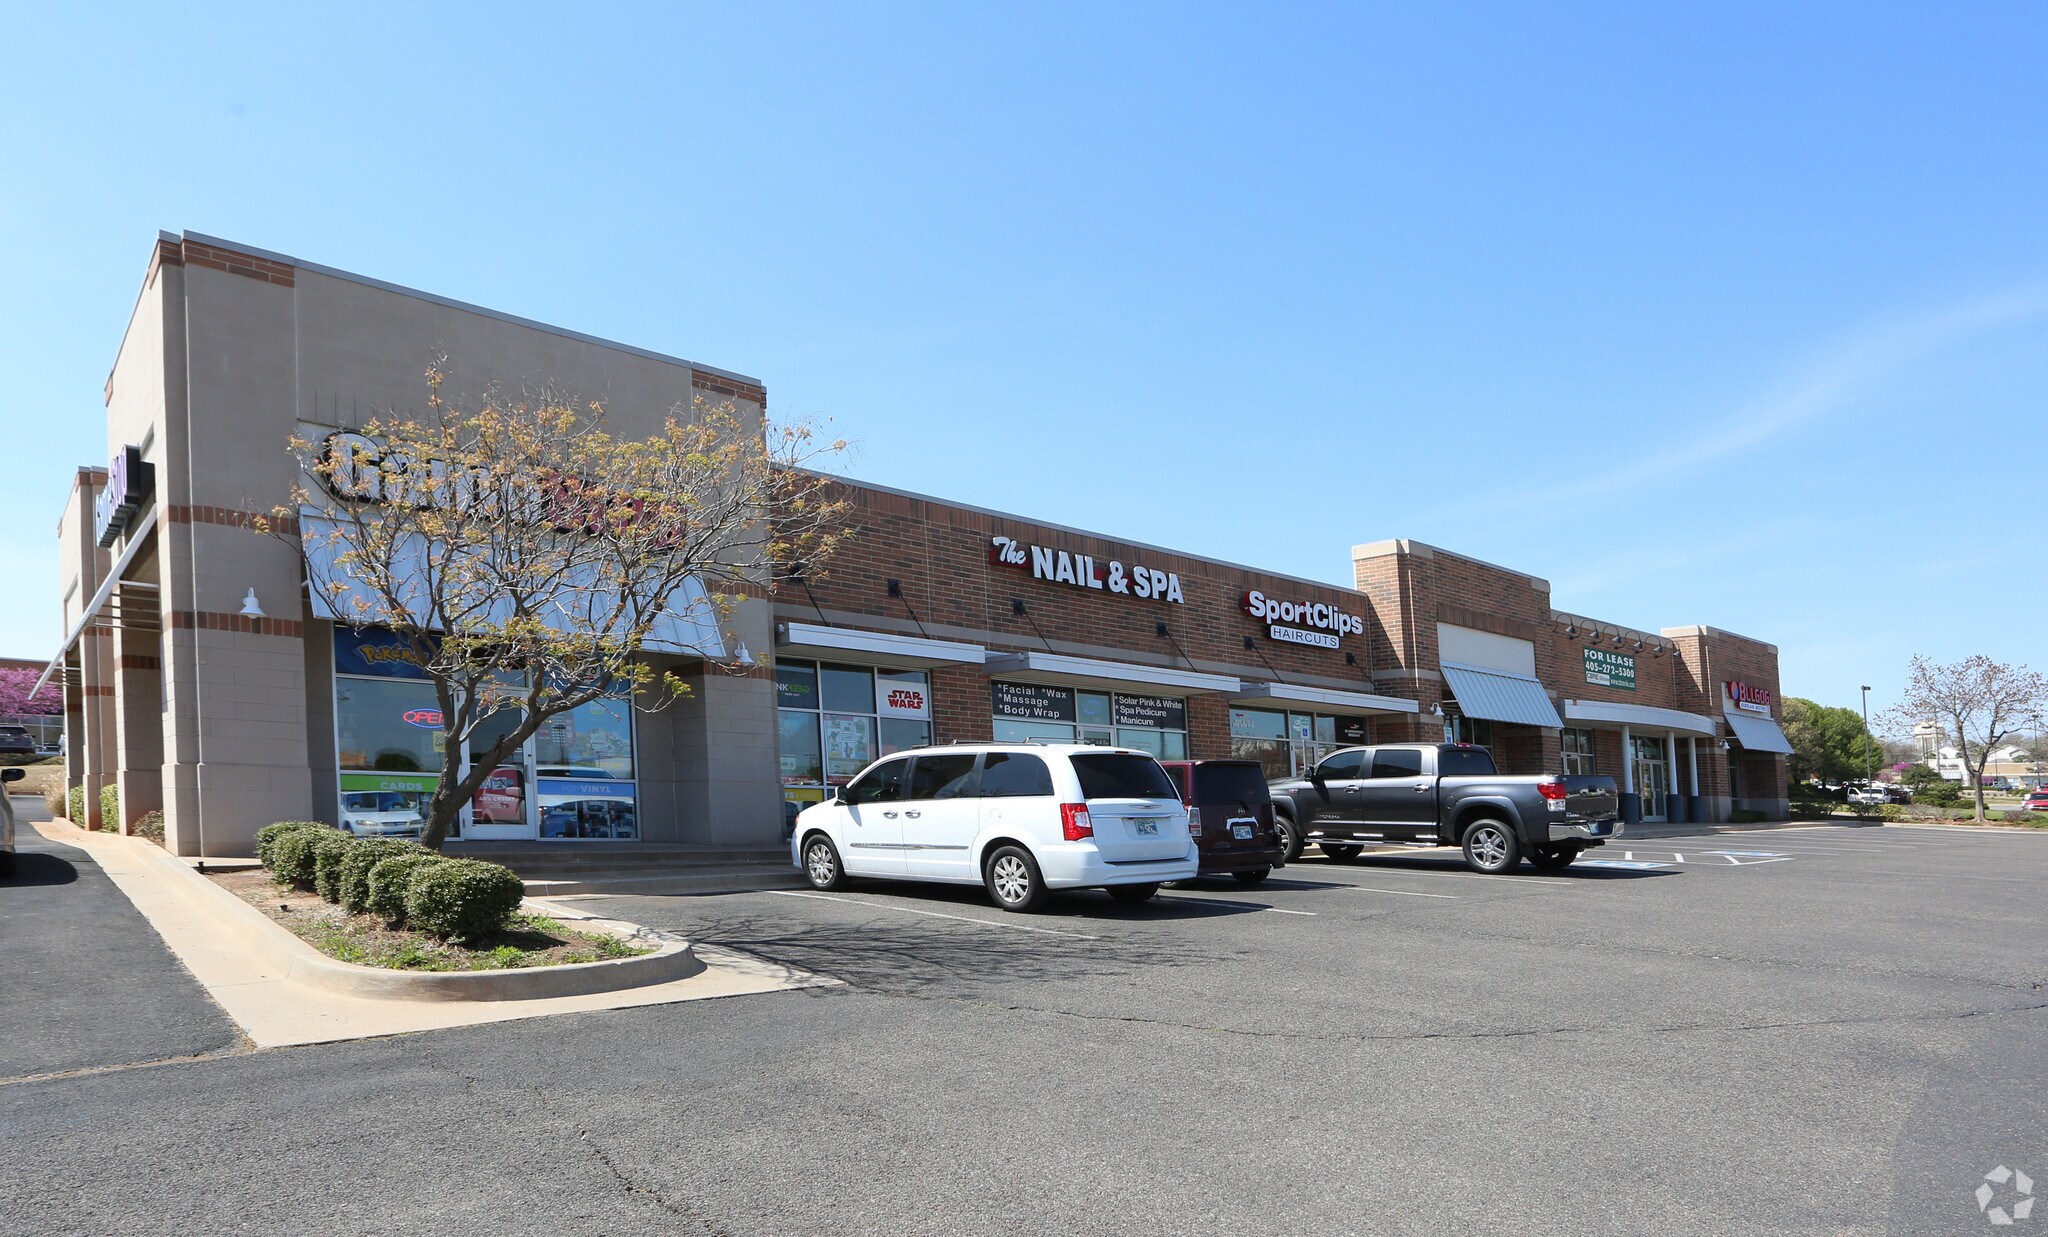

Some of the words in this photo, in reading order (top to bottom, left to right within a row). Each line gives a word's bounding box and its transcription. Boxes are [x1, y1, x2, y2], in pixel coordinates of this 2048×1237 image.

[993, 536, 1027, 565] The
[1031, 545, 1103, 590] NAIL
[1108, 561, 1129, 595] &
[1133, 566, 1185, 604] SPA
[1249, 591, 1363, 637] SportClips
[1273, 627, 1338, 647] HAIRCUTS
[1584, 649, 1604, 661] FOR
[1606, 653, 1634, 667] LEASE
[1585, 661, 1635, 678] 405-272-5300
[888, 689, 923, 701] STAR
[888, 699, 923, 710] WARS
[1139, 698, 1155, 707] Pink
[1156, 700, 1162, 708] &
[1162, 700, 1182, 710] White
[1034, 707, 1060, 719] Wrap
[1135, 707, 1167, 718] Pedicure
[380, 782, 423, 791] CARDS
[580, 784, 612, 794] VINYL
